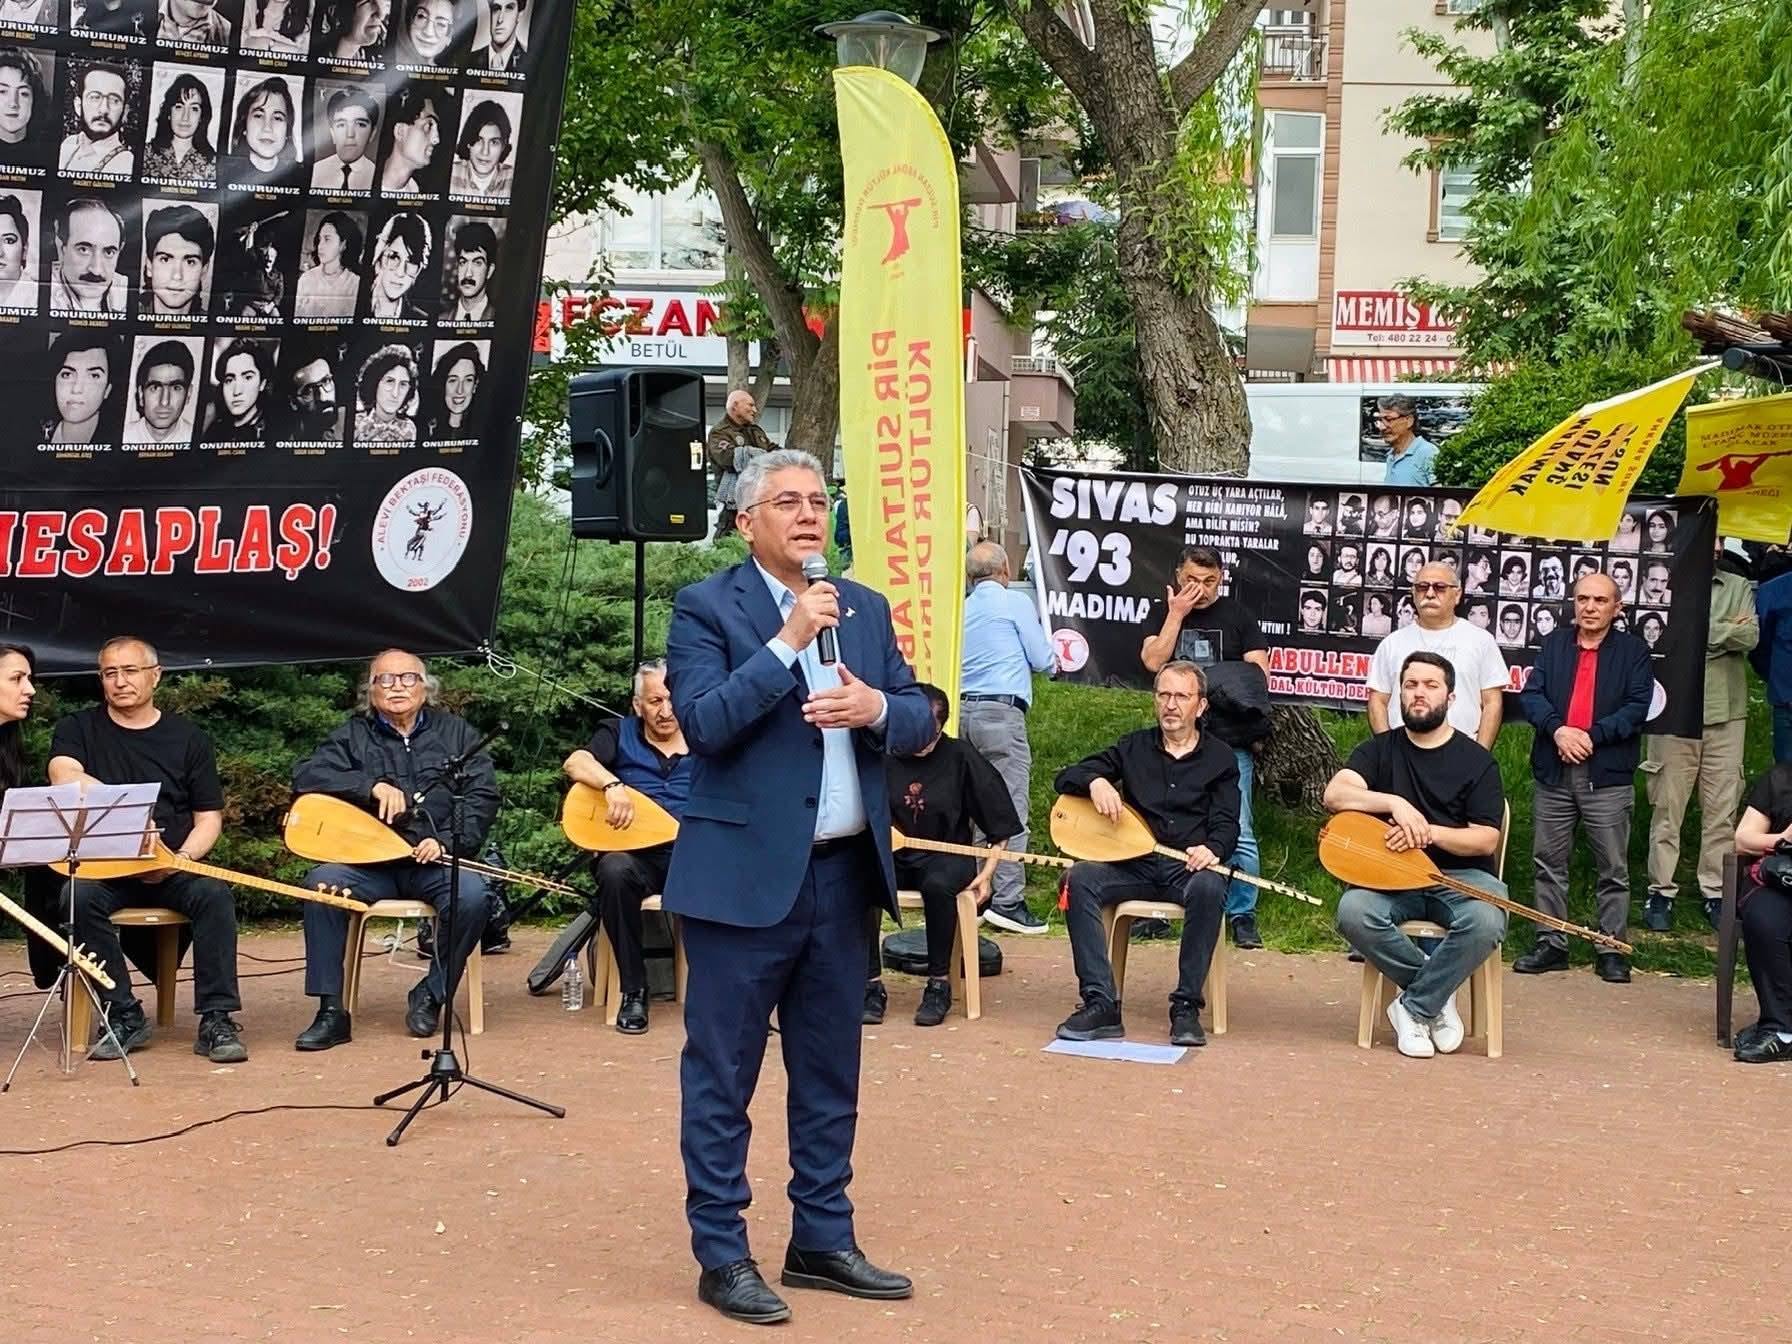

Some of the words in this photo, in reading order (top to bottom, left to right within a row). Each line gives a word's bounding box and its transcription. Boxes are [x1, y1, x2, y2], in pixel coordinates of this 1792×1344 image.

[70, 29, 147, 45] ONURUMUZ
[155, 39, 229, 55] ONURUMUZ
[239, 49, 308, 62] ONURUMUZ
[317, 56, 386, 70] ONURUMUZ
[395, 64, 459, 75] ONURUMUZ
[466, 68, 526, 81] ONURUMUZ
[57, 170, 132, 183] ONURUMUZ
[141, 176, 217, 189] ONURUMUZ
[228, 183, 300, 195] ONURUMUZ
[308, 188, 371, 198] ONURUMUZ
[380, 191, 440, 201] ONURUMUZ
[448, 194, 511, 205] ONURUMUZ
[49, 310, 127, 321] ONURUMUZ
[1336, 291, 1421, 331] MEMİŞ
[137, 314, 208, 323] ONURUMUZ
[216, 316, 284, 325] ONURUMUZ
[293, 317, 354, 325] ONURUMUZ
[362, 318, 428, 327] ONURUMUZ
[436, 320, 495, 328] ONURUMUZ
[1409, 333, 1421, 343] 22
[1425, 333, 1437, 343] 24
[631, 339, 687, 359] BETÜL
[36, 444, 112, 452] ONURUMUZ
[121, 443, 191, 451] ONURUMUZ
[200, 441, 266, 450] ONURUMUZ
[275, 440, 344, 448] ONURUMUZ
[422, 439, 479, 448] ONURUMUZ
[1188, 485, 1210, 497] OTUZ
[1212, 483, 1223, 500] ÜÇ
[1225, 487, 1246, 498] YARA
[1248, 487, 1285, 503] AÇTILAR,
[1050, 477, 1179, 526] SIVAS
[1185, 517, 1203, 529] AMA
[1185, 533, 1197, 545] BU
[1199, 534, 1240, 548] TOPRAKTA
[1242, 536, 1279, 551] YARALAR
[407, 577, 429, 588] 2002
[1048, 590, 1162, 624] MADIMA
[1266, 646, 1372, 679] ABULLEN
[1295, 677, 1345, 699] KÜLTÜR
